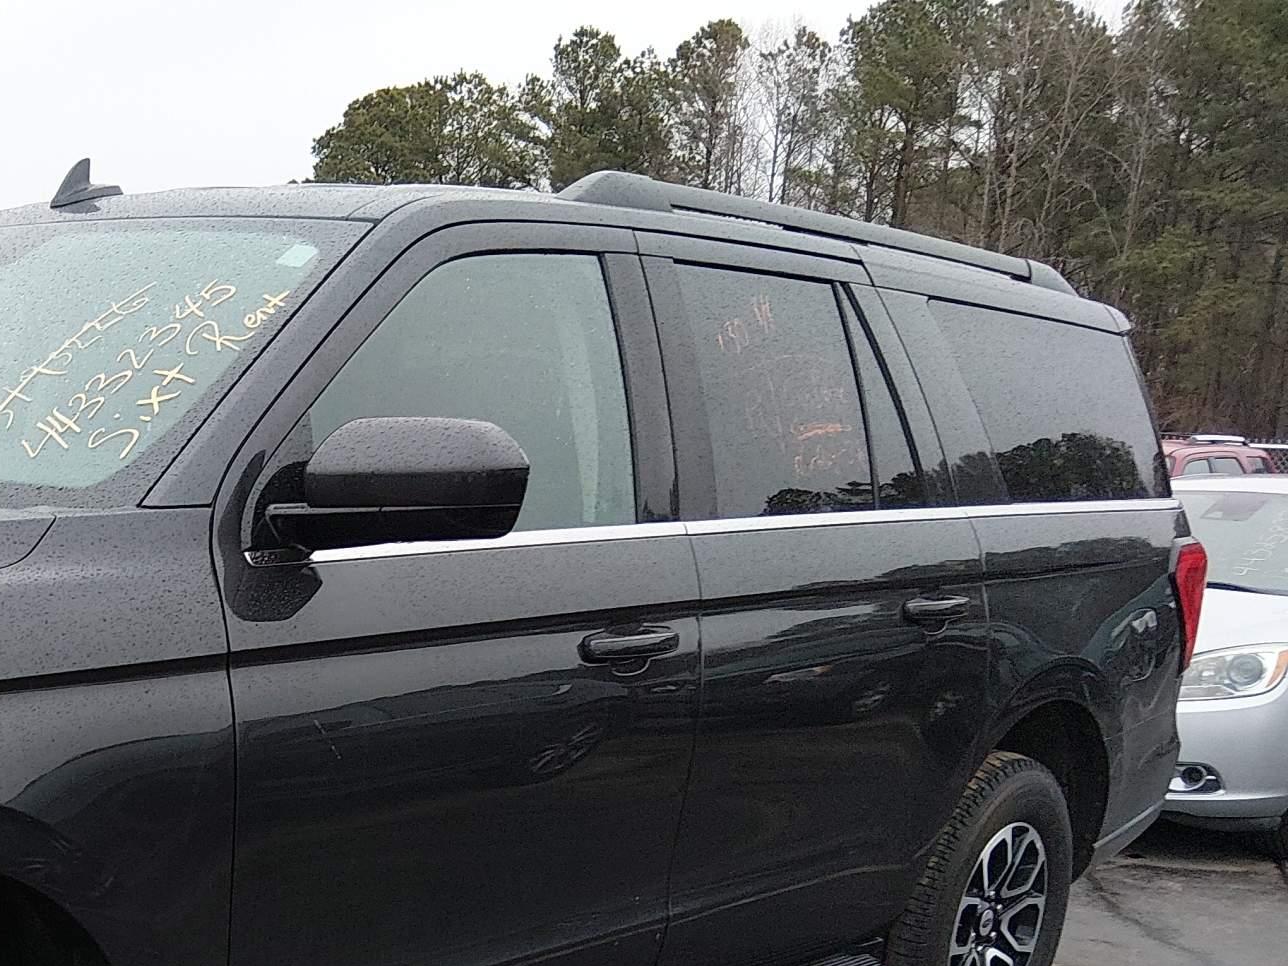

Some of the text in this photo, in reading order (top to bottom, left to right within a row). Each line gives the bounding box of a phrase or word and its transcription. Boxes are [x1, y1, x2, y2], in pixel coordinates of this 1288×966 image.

[21, 279, 236, 458] 44332345
[88, 290, 290, 459] Sixt Rent
